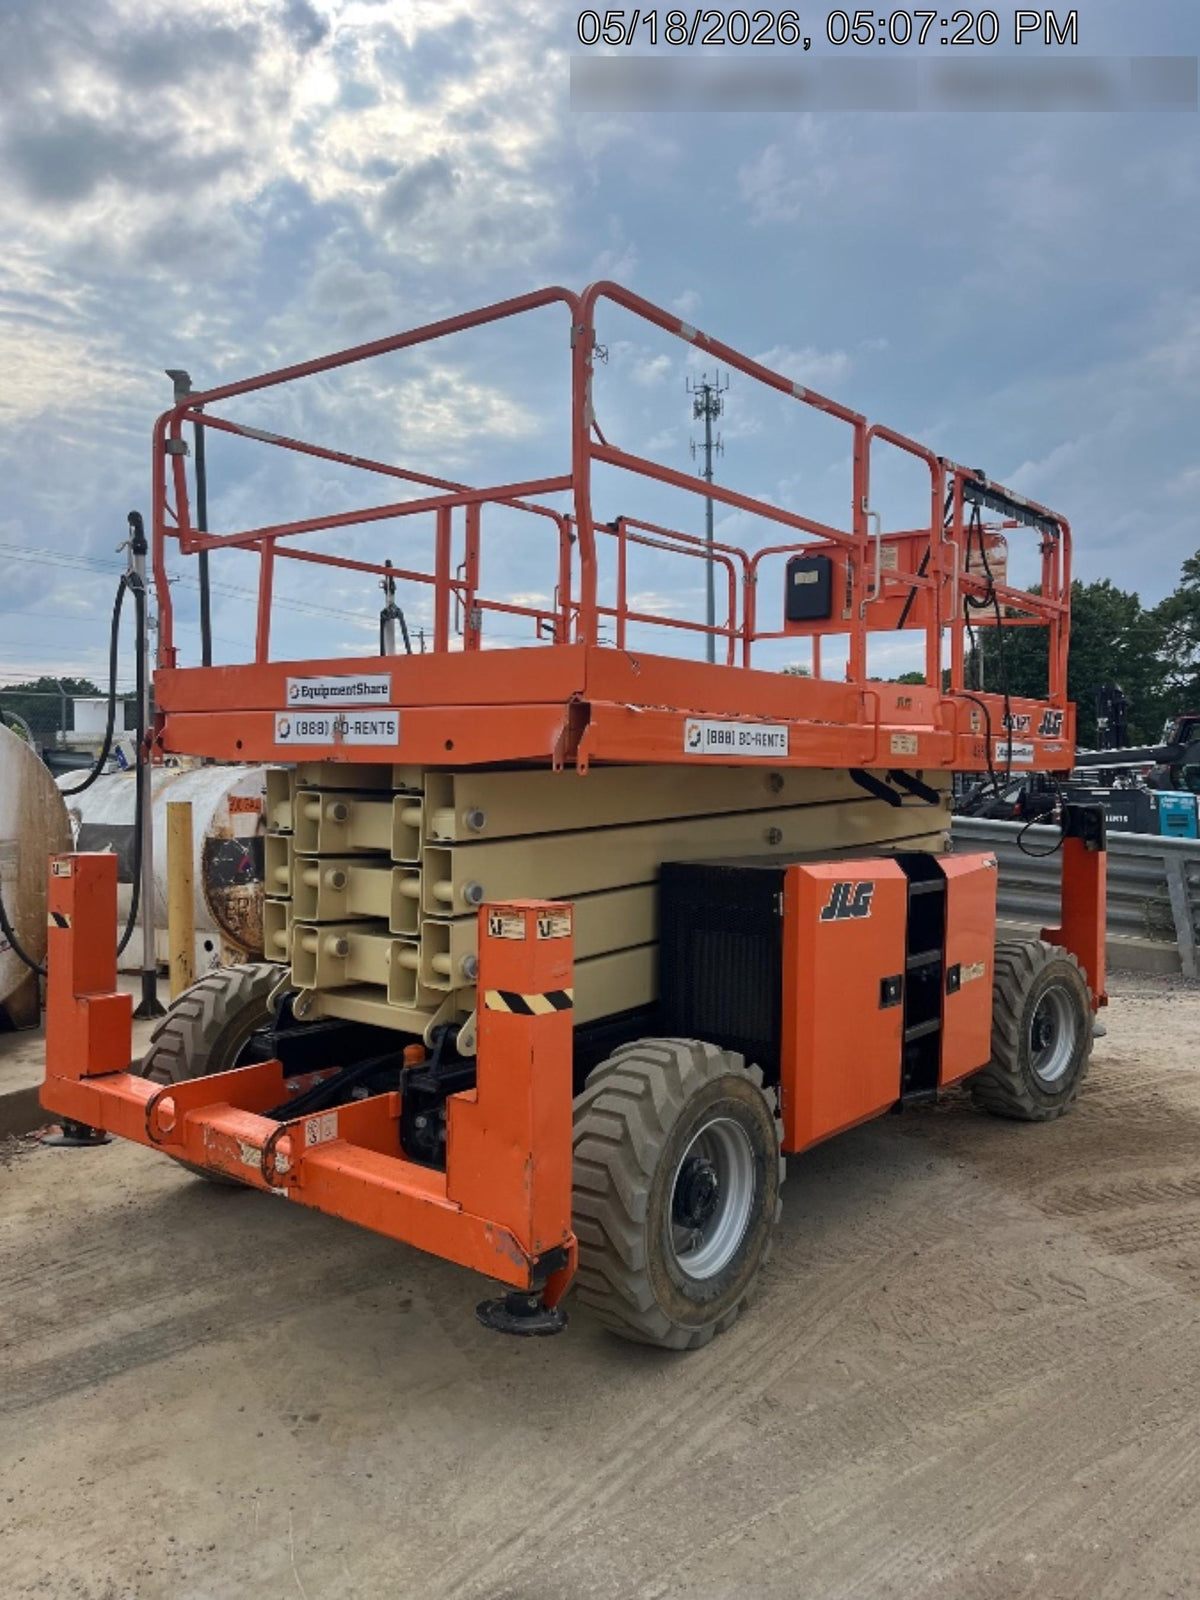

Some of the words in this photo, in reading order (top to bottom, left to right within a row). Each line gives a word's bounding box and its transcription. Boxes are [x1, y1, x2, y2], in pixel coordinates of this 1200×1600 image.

[300, 682, 388, 699] EquipmentShare
[1037, 709, 1064, 736] JLG
[706, 728, 736, 746] (888)
[819, 881, 876, 923] JLG
